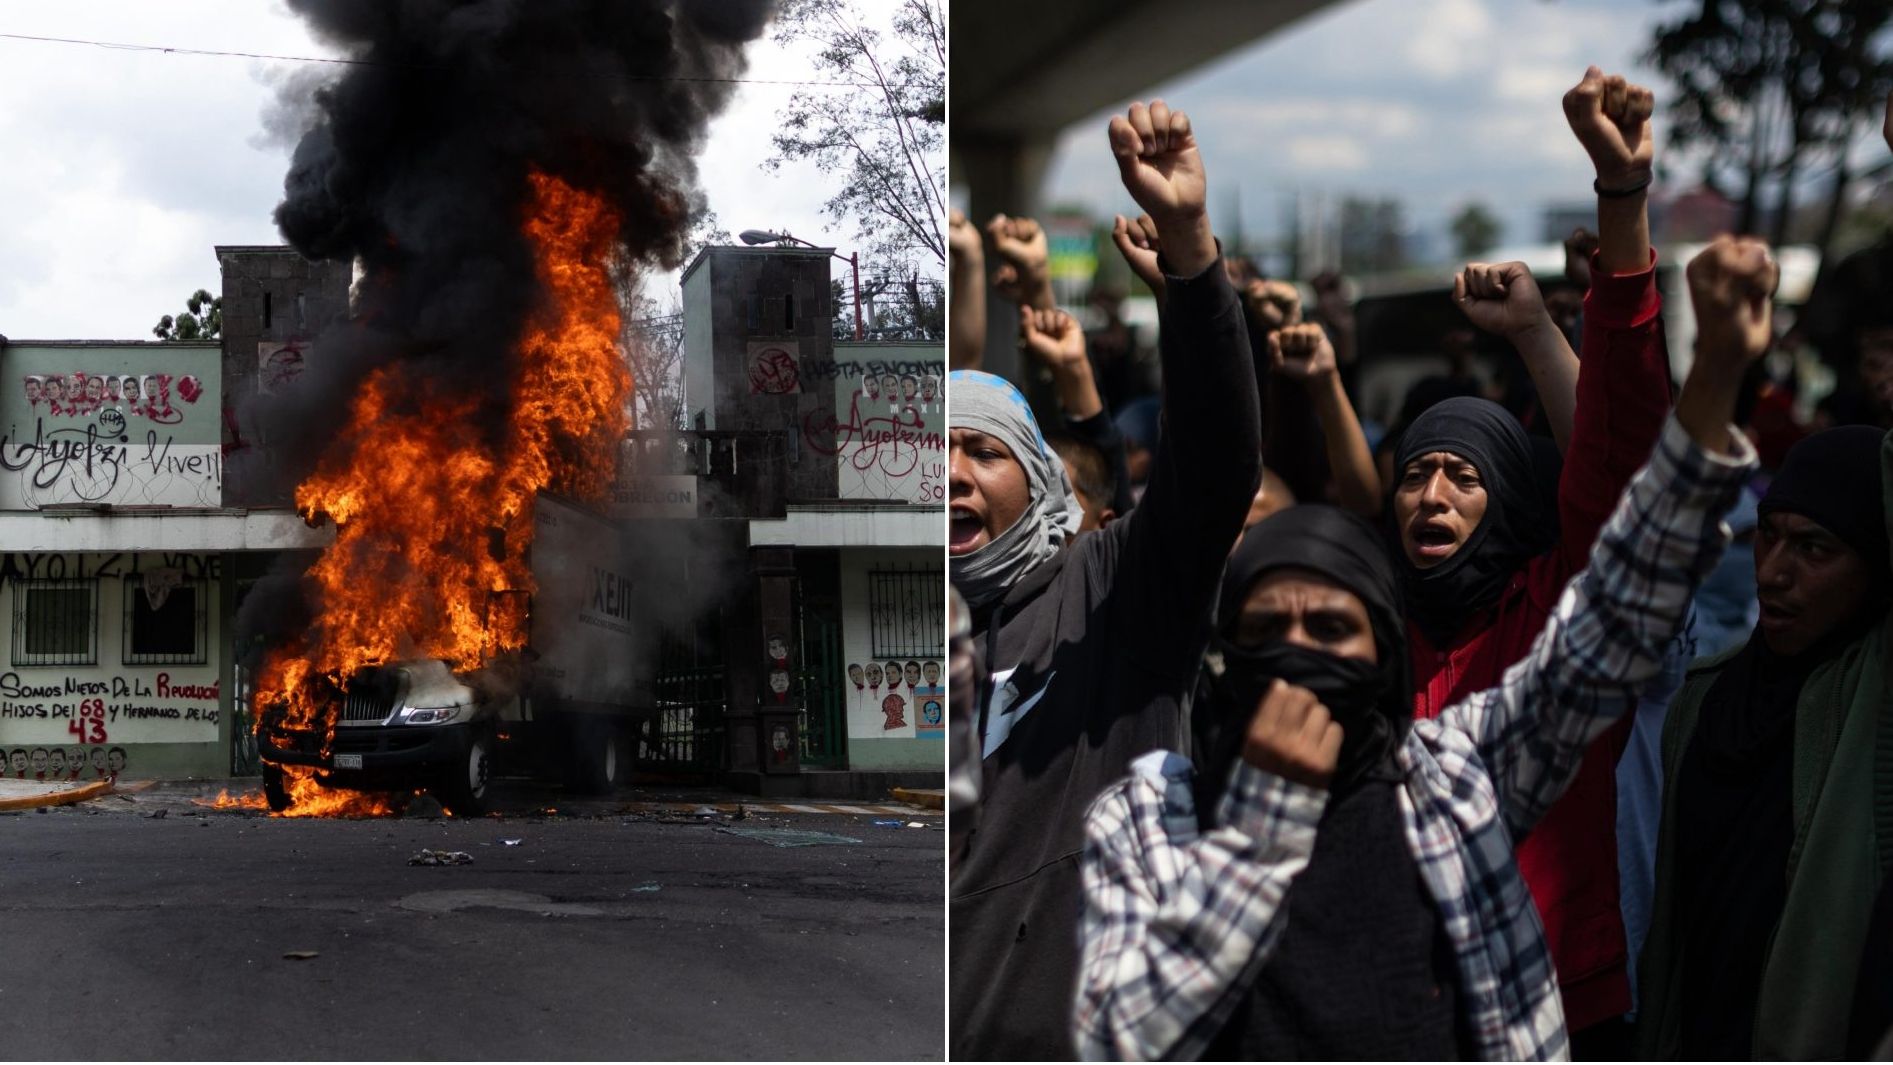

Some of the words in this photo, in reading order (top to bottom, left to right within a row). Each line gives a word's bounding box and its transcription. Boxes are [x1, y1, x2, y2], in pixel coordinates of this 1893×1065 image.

[921, 462, 945, 479] LU
[919, 481, 945, 502] SO
[0, 672, 62, 699] SOMOS
[64, 676, 109, 696] NIETOS
[112, 676, 130, 699] DE
[135, 677, 152, 697] LA
[1, 701, 48, 719] HIJOS
[80, 698, 105, 719] 68
[123, 702, 181, 719] HERMANOS
[68, 717, 108, 744] 43
